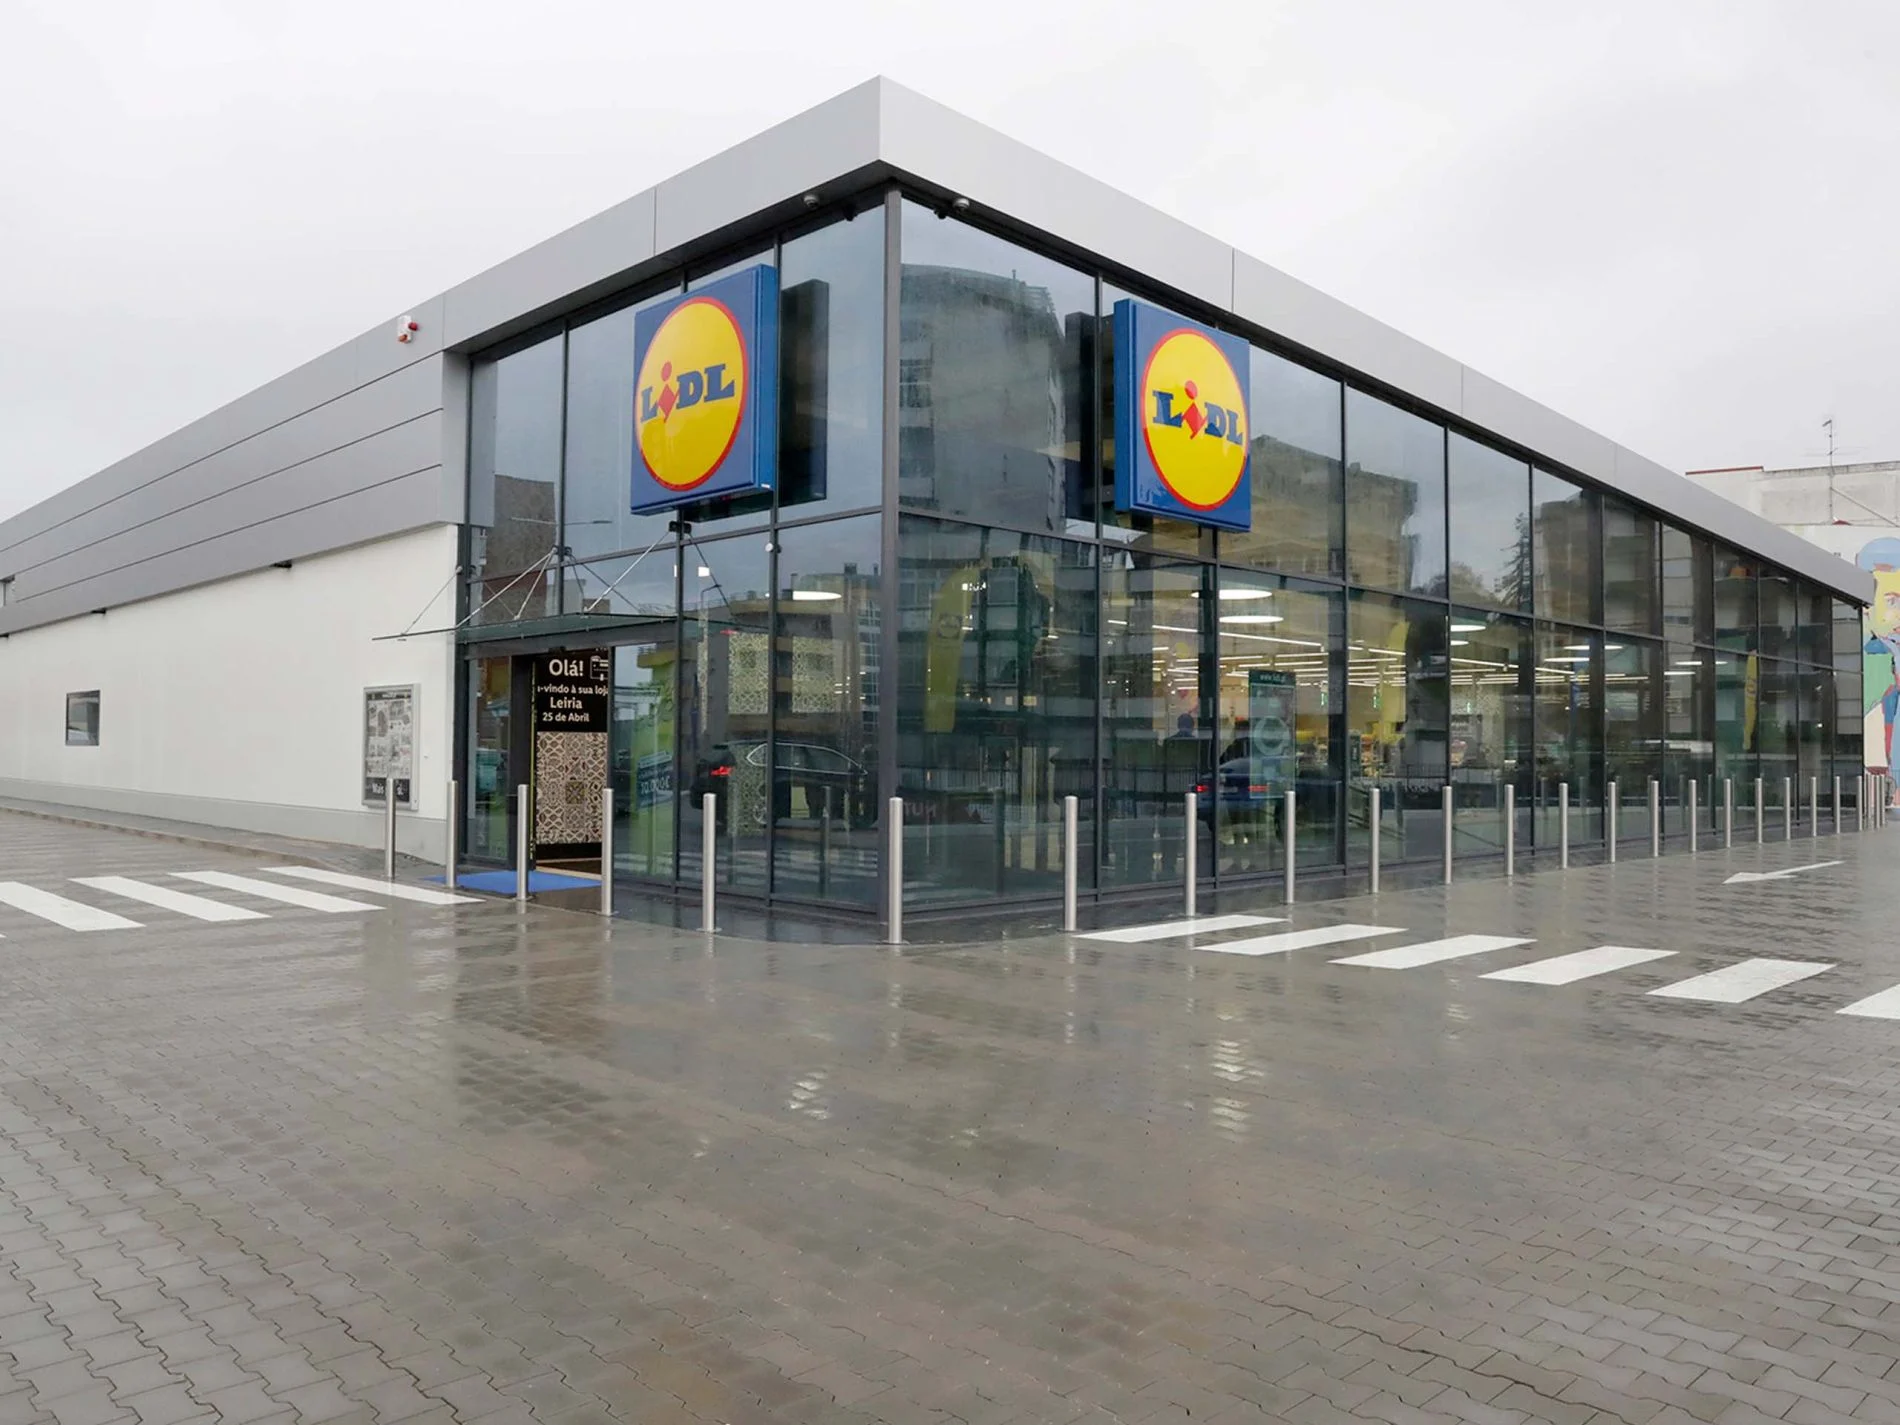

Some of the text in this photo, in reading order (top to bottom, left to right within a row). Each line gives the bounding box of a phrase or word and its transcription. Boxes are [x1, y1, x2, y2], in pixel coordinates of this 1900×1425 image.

[549, 659, 583, 676] Olá!
[550, 696, 583, 709] Leiria
[542, 712, 590, 722] 25 de Abril
